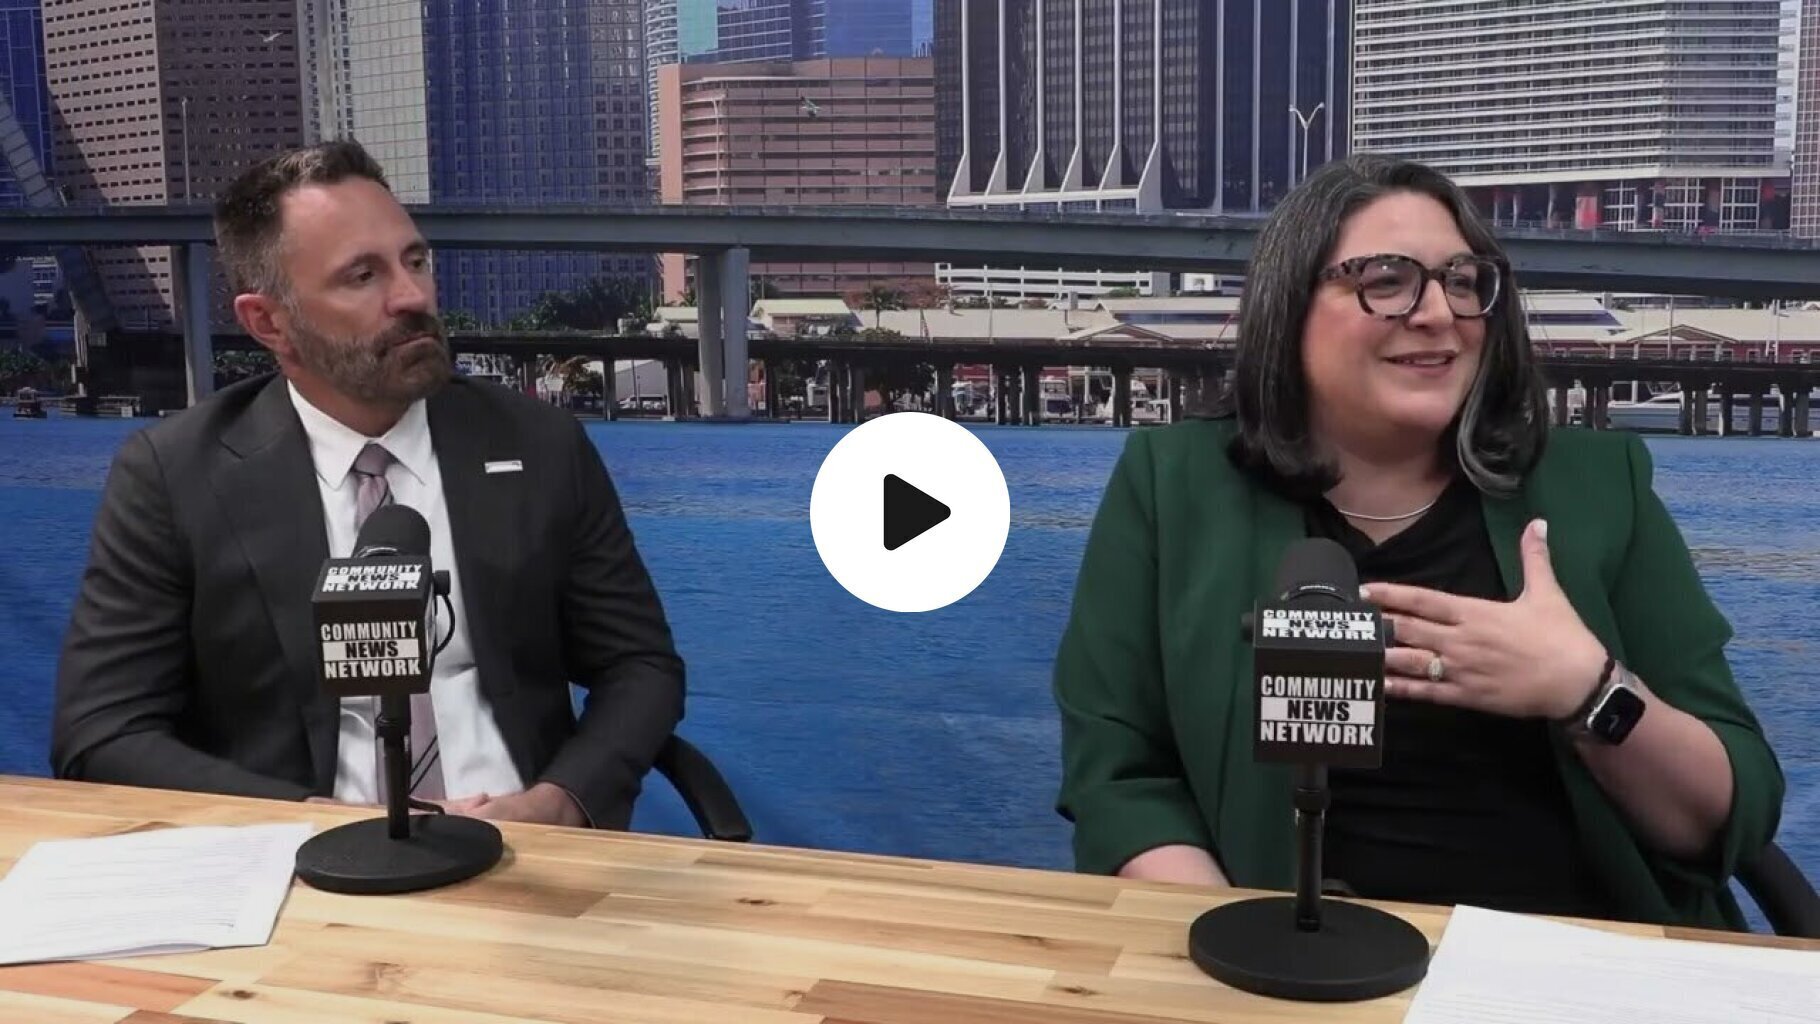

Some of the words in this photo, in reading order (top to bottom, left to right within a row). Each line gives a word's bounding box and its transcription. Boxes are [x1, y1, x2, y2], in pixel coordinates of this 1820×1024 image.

[328, 564, 422, 576] COMMUNITY
[348, 573, 399, 582] NEWS
[322, 580, 419, 592] NETWORK
[1262, 609, 1374, 621] COMMUNITY
[320, 621, 416, 640] COMMUNITY
[1289, 619, 1350, 630] NEWS
[1262, 627, 1376, 640] NETWORK
[346, 641, 398, 658] NEWS
[325, 659, 421, 678] NETWORK
[1261, 676, 1375, 699] COMMUNITY
[1287, 700, 1350, 721] NEWS
[1261, 721, 1374, 745] NETWORK
